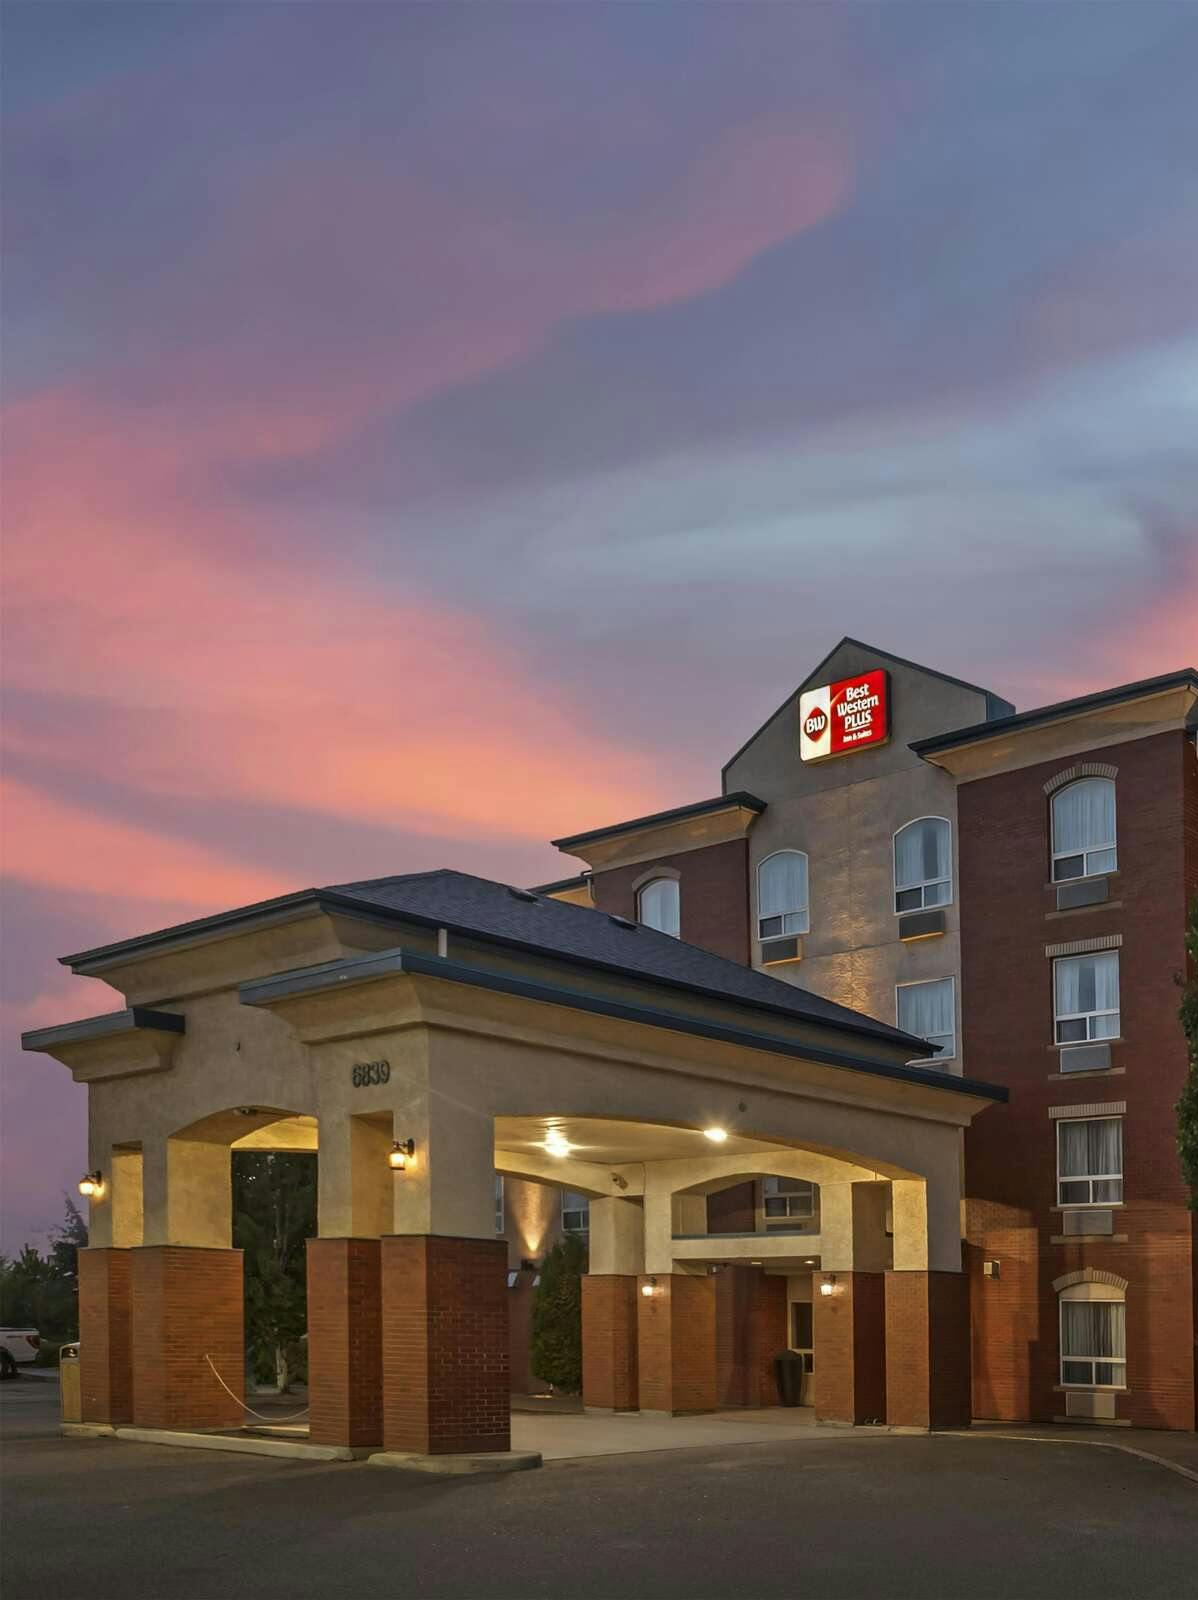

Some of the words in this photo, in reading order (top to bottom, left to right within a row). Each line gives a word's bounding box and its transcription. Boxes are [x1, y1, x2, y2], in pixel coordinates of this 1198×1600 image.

[846, 683, 870, 701] Best
[836, 694, 879, 717] Western
[806, 715, 826, 733] BW
[844, 709, 873, 729] PLUS
[352, 1060, 390, 1088] 6839
